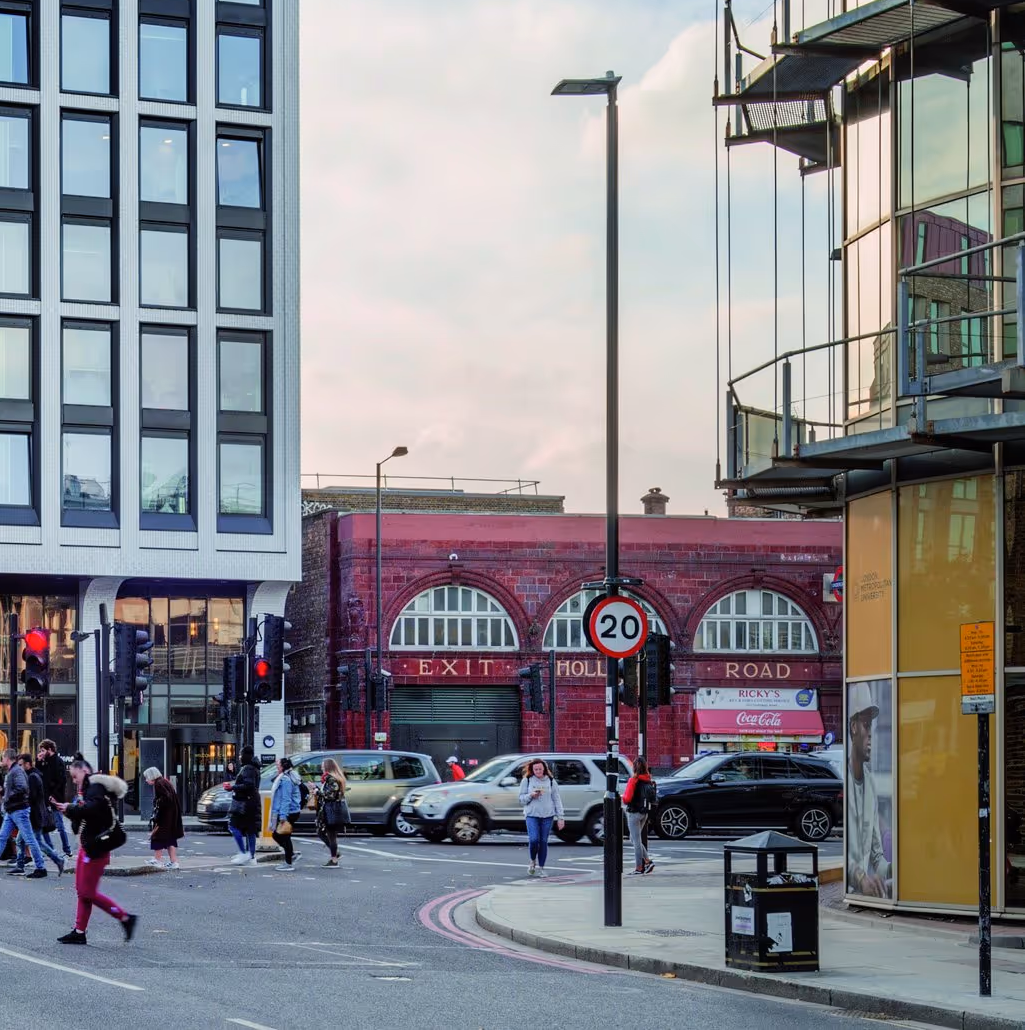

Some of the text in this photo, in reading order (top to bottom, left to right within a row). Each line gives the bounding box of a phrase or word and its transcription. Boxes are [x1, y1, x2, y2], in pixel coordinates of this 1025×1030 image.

[861, 590, 885, 602] UNIVERSITY
[600, 614, 640, 640] 20
[419, 659, 494, 676] EXIT
[557, 660, 791, 679] HOLL ROAD
[738, 689, 781, 698] RICKY'S
[736, 711, 783, 726] Coca-Cola
